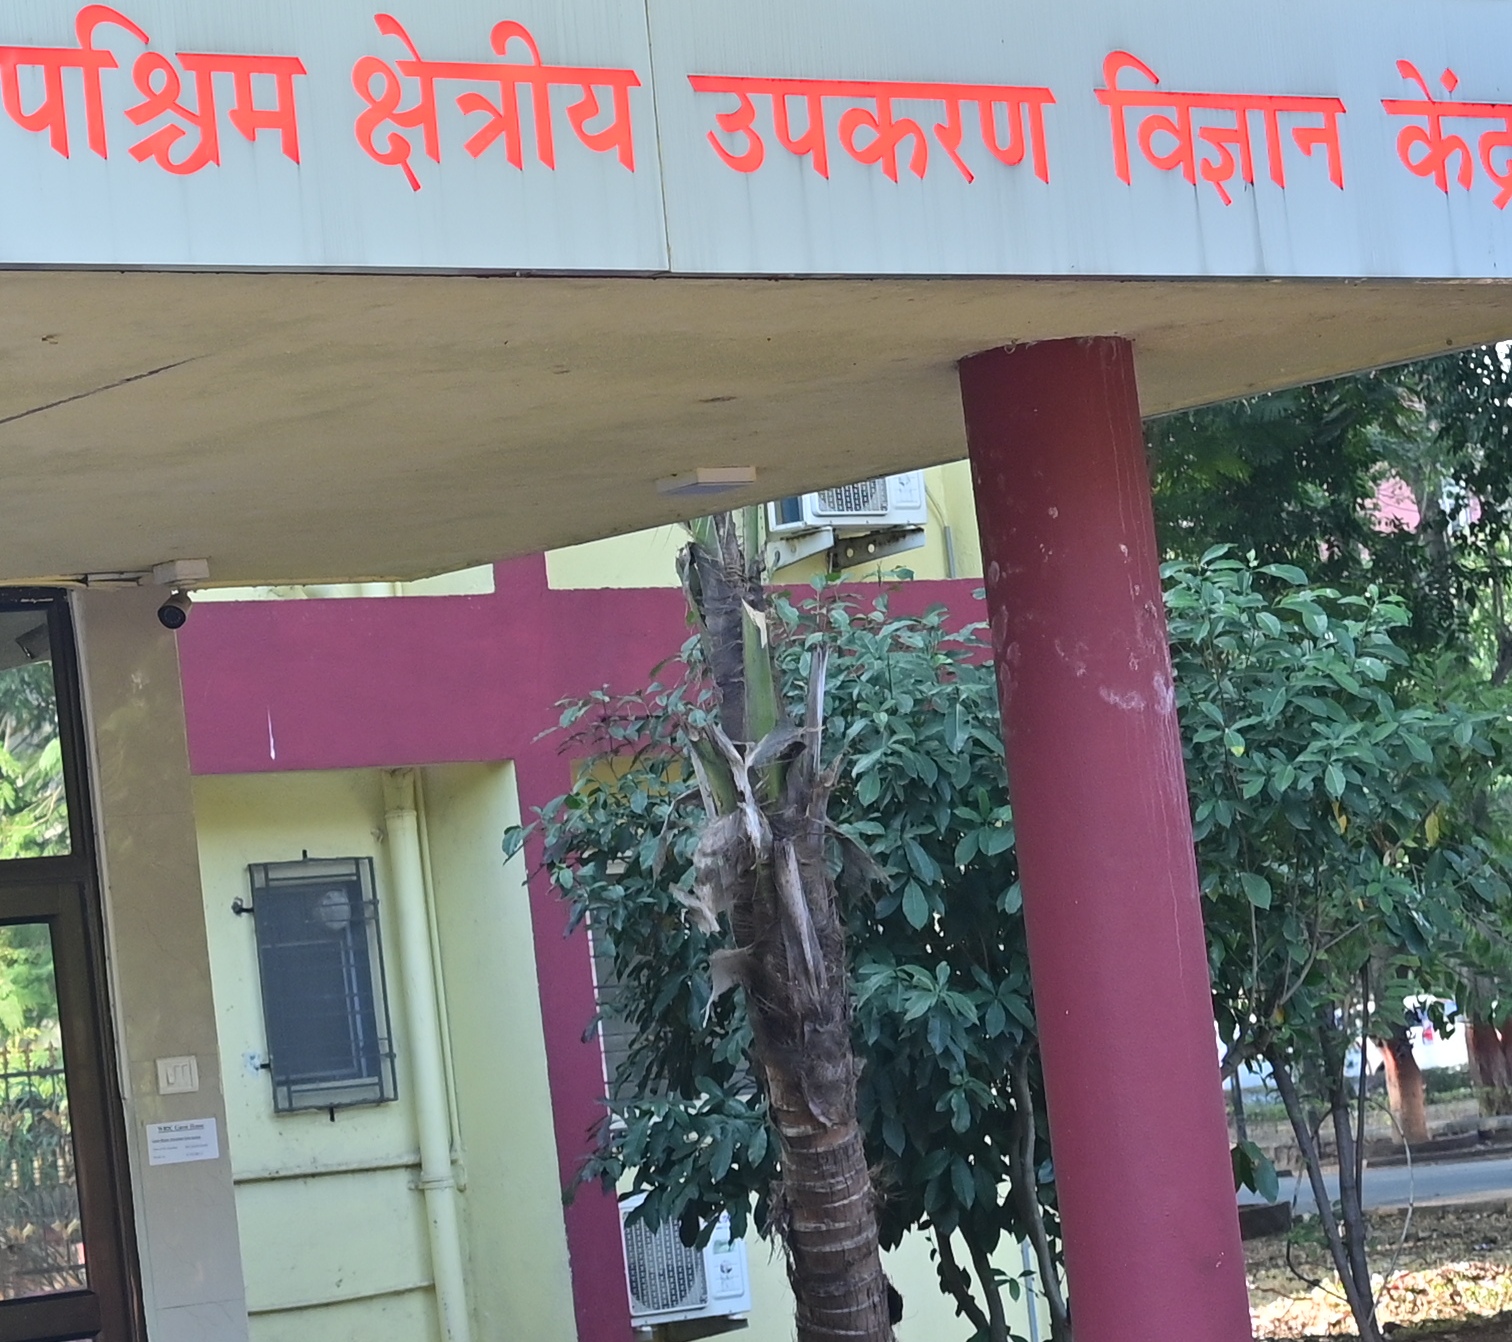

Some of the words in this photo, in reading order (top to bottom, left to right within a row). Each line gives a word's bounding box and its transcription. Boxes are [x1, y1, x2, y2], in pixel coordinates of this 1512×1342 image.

[351, 13, 642, 192] क्षेत्रीय
[688, 74, 1057, 183] उपकरण
[1094, 50, 1347, 206] विज्ञान
